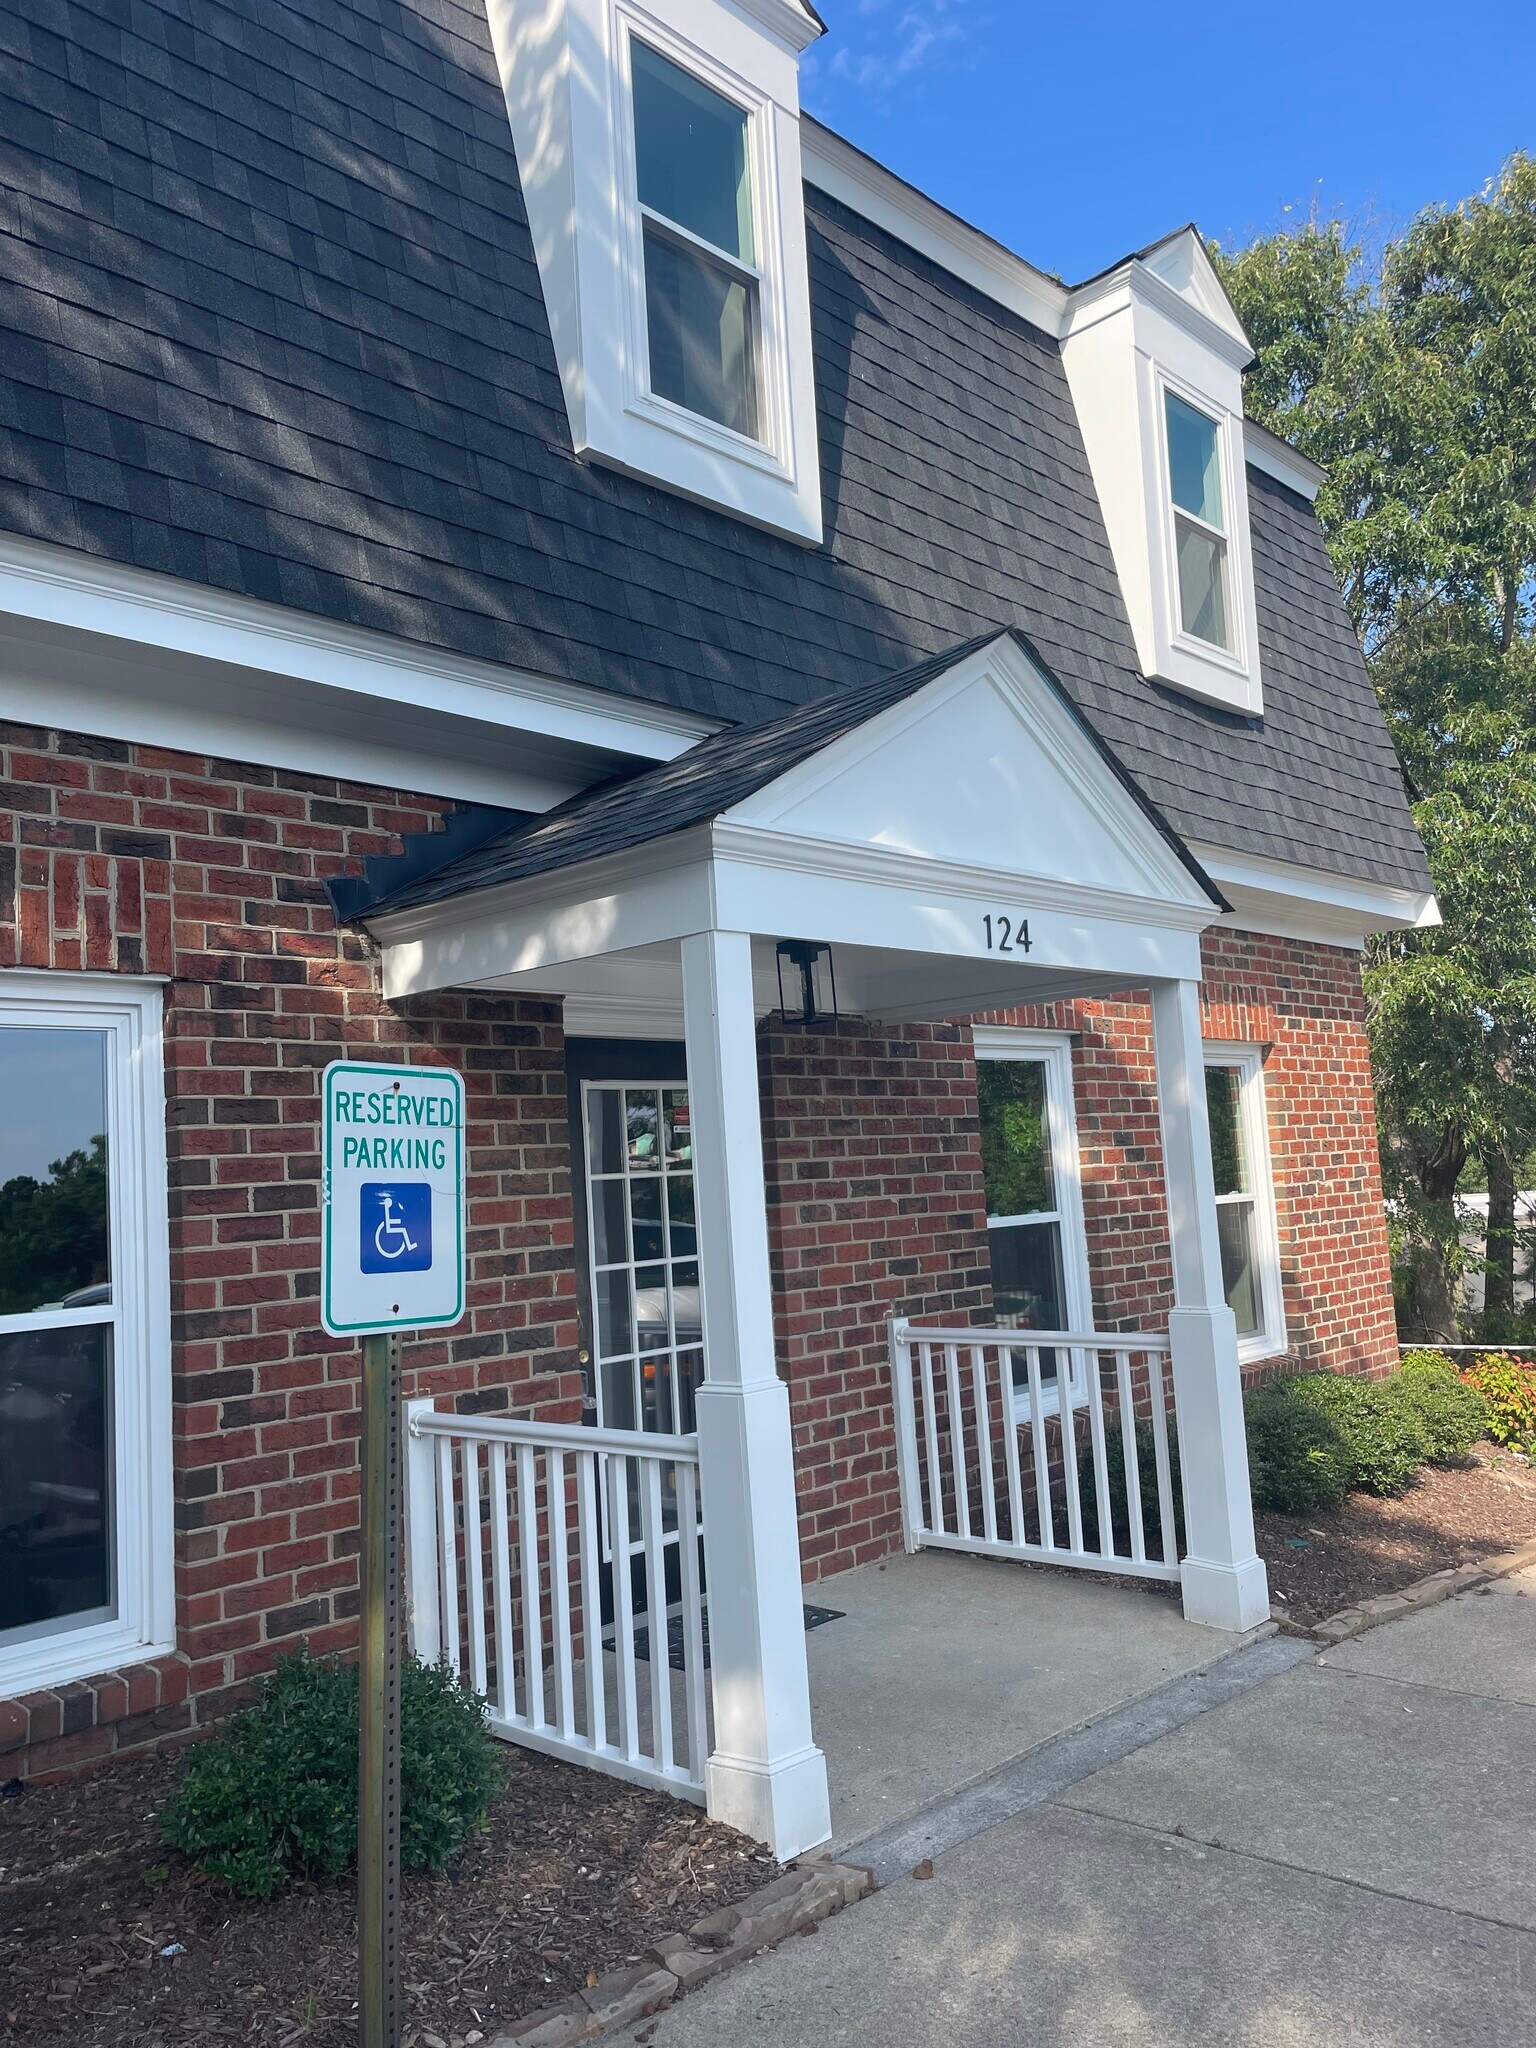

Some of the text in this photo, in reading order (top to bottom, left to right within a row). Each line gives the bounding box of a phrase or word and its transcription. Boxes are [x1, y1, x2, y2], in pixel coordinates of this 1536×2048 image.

[983, 914, 1033, 953] 124
[336, 1091, 454, 1127] RESERVED
[343, 1137, 446, 1170] PARKING
